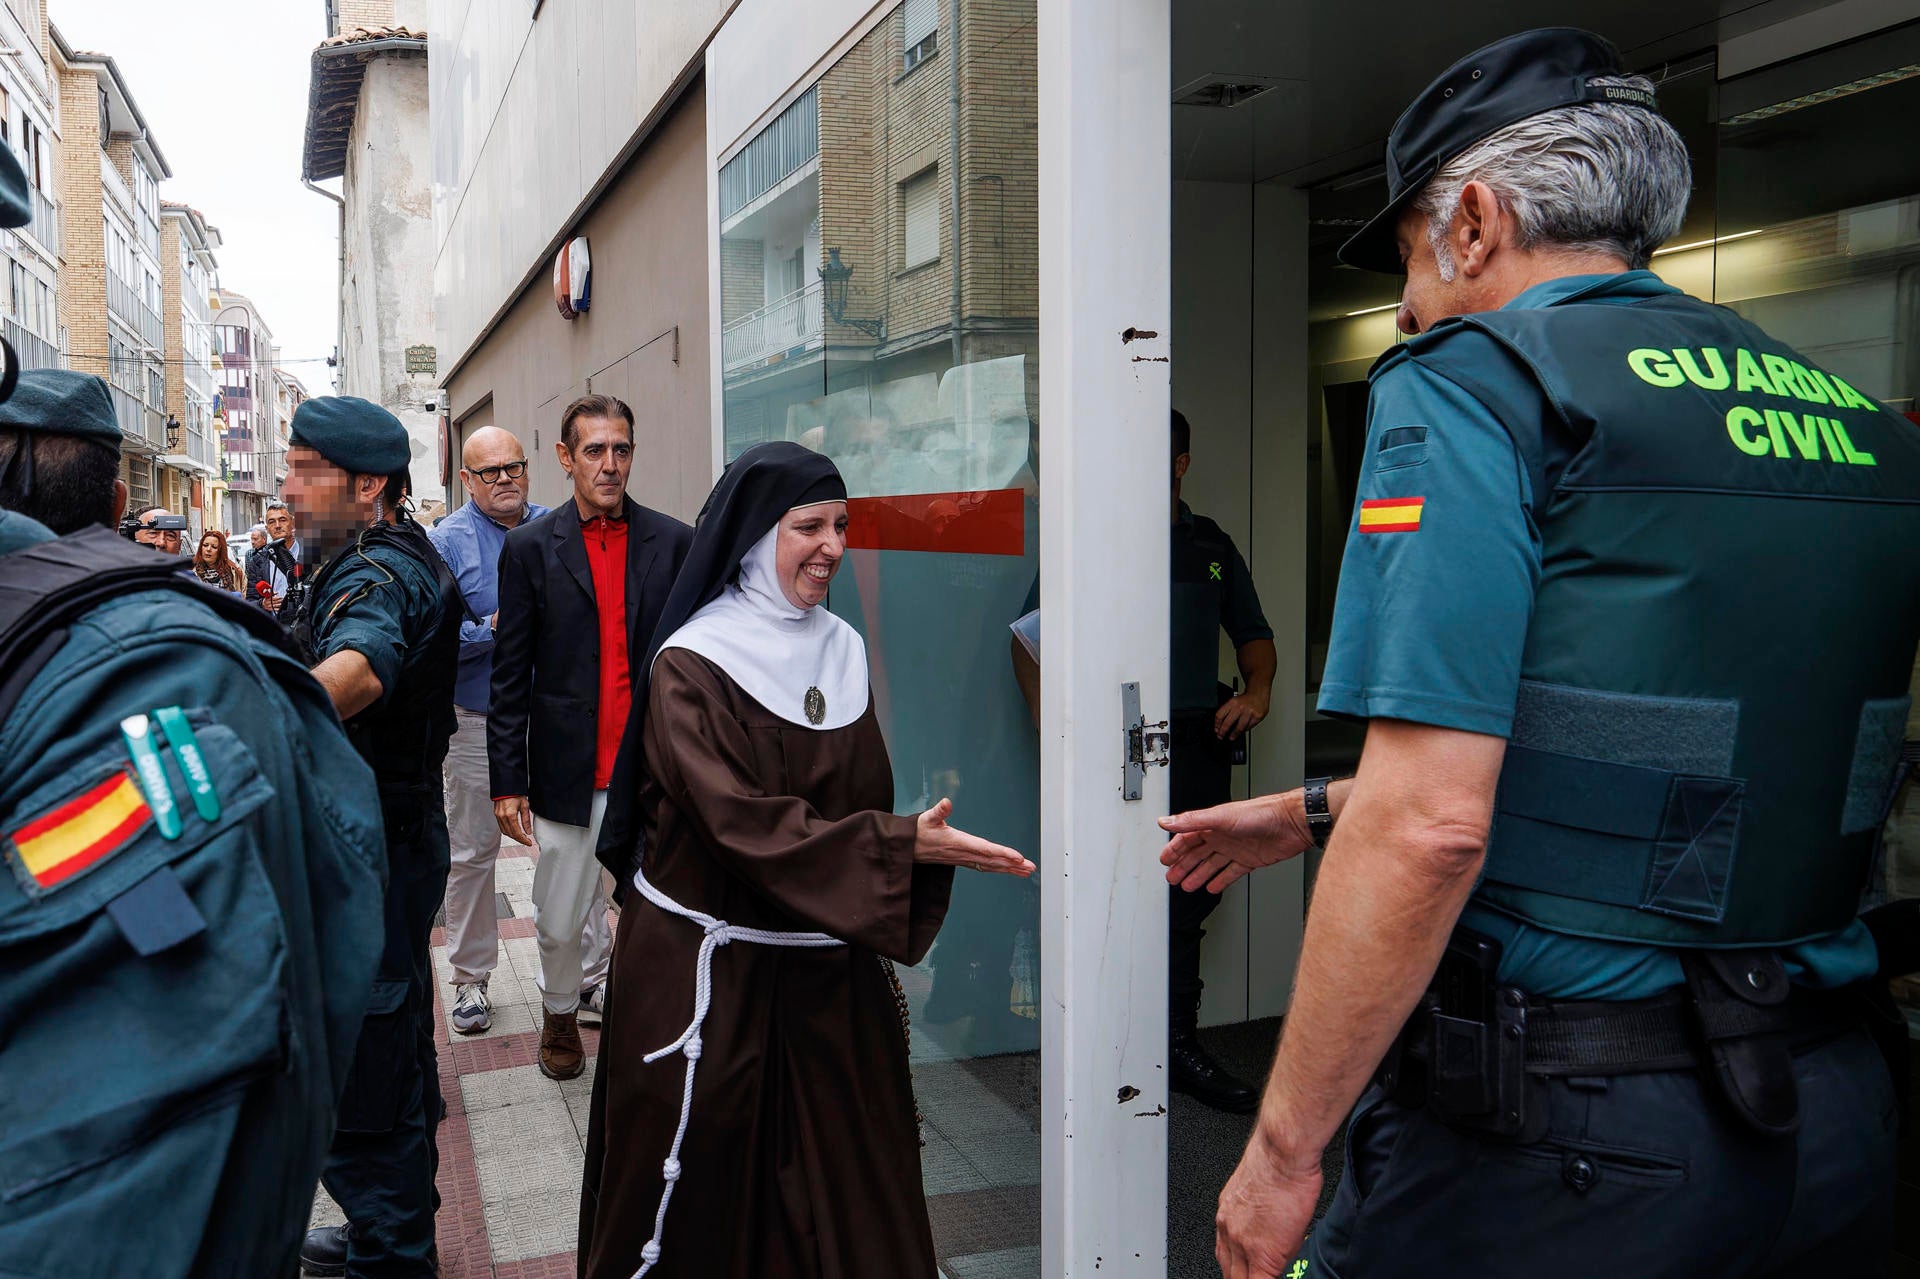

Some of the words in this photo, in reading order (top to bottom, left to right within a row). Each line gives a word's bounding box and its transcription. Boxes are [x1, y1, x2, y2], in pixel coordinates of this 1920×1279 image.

[1605, 87, 1646, 103] GUARDIA
[1627, 347, 1879, 412] GUARDIA
[1726, 406, 1878, 466] CIVIL
